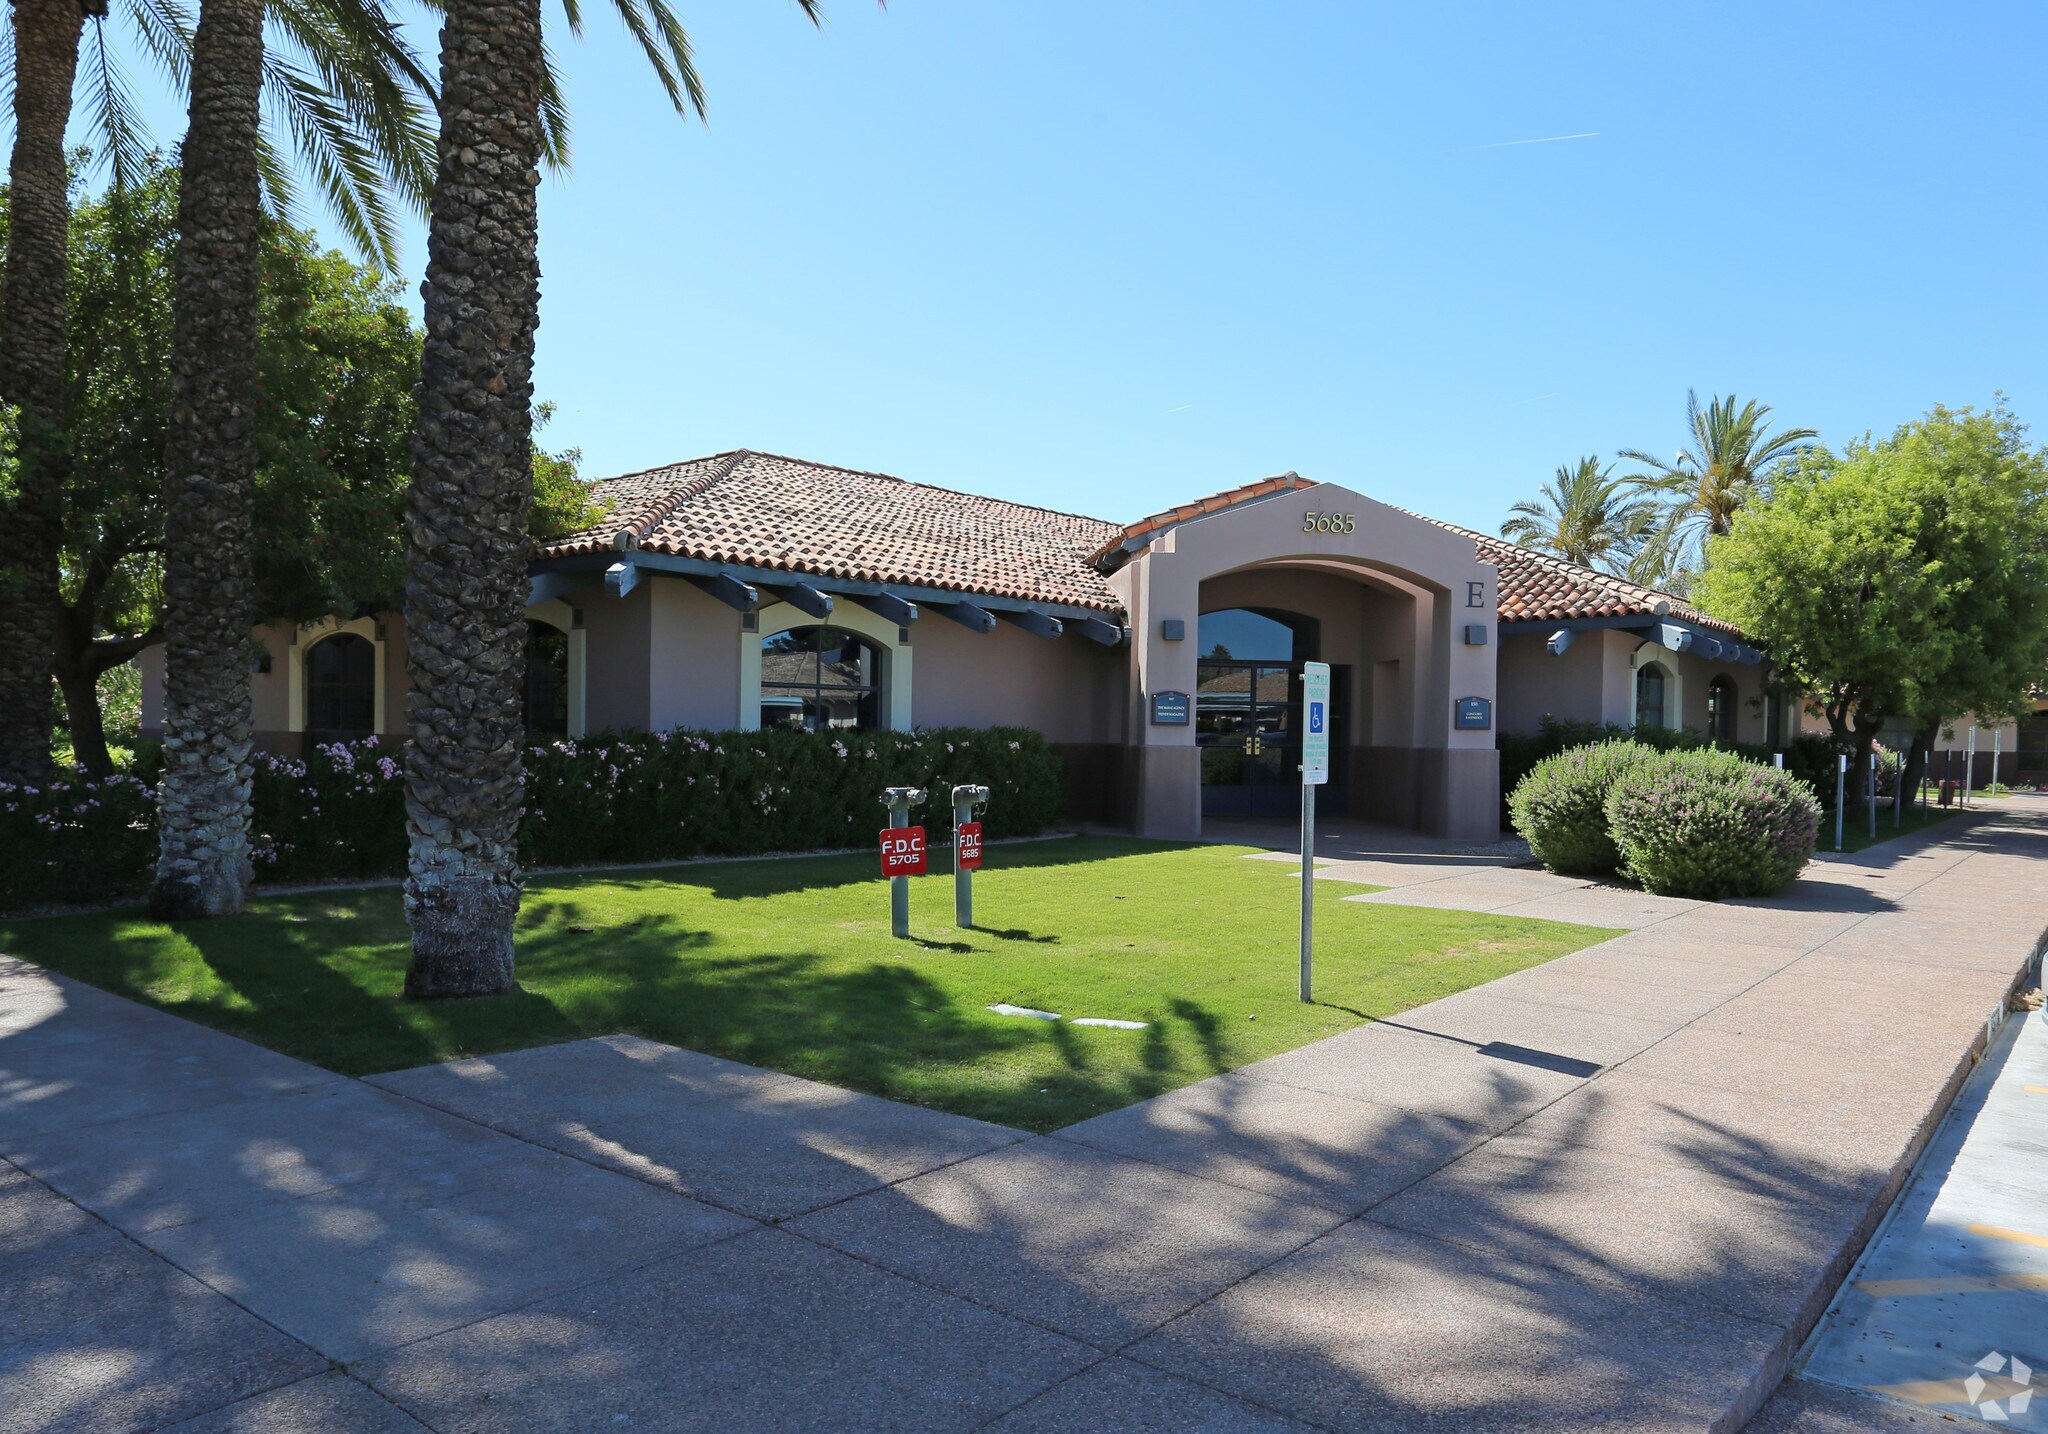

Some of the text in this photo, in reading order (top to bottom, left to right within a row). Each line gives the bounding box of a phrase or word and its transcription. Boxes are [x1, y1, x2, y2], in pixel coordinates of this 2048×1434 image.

[1303, 511, 1356, 534] 5685
[1465, 581, 1485, 608] E
[882, 837, 925, 854] F.D.C.
[960, 833, 982, 848] F.D.C.
[889, 854, 920, 866] 5705
[962, 848, 979, 859] 5685
